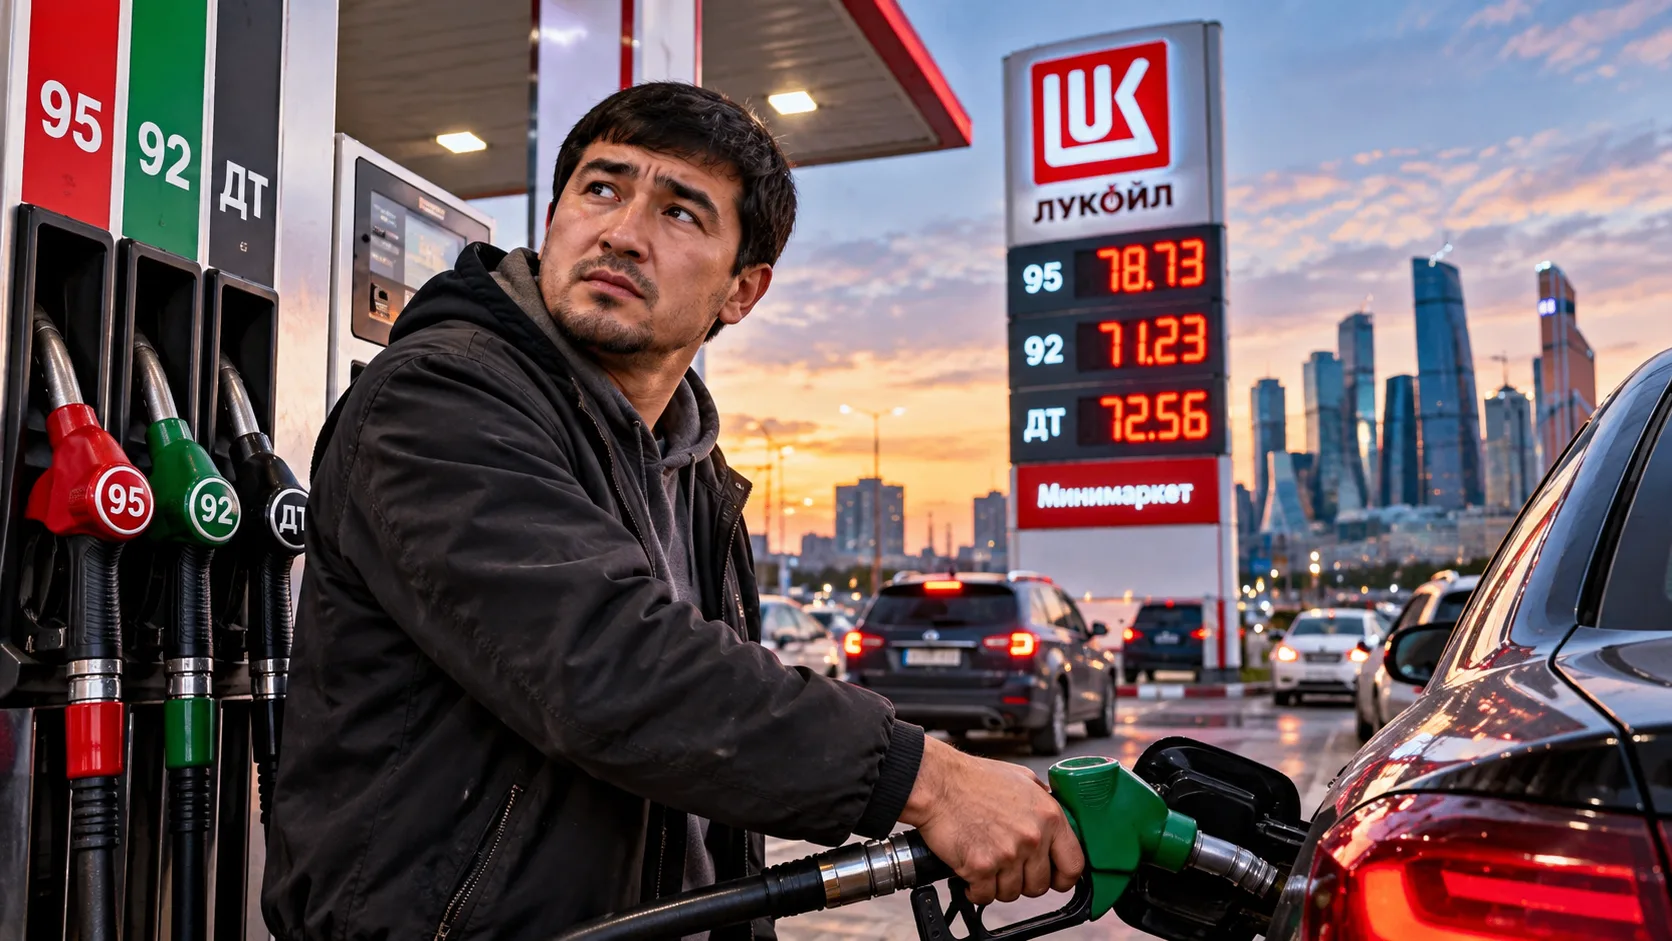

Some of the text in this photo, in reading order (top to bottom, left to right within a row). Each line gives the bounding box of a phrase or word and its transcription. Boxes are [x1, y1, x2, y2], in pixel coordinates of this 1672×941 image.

[40, 79, 102, 153] 95
[1043, 57, 1158, 168] LUK
[138, 121, 191, 191] 92
[219, 159, 269, 221] ДТ
[1034, 181, 1173, 223] ЛУКОЙЛ
[1022, 238, 1205, 294] 95 78.73
[1023, 313, 1207, 367] 92 71.23
[1023, 391, 1209, 442] ДТ 72.56
[108, 483, 145, 517] 95
[200, 493, 233, 525] 92
[1037, 482, 1194, 511] Минимаркет
